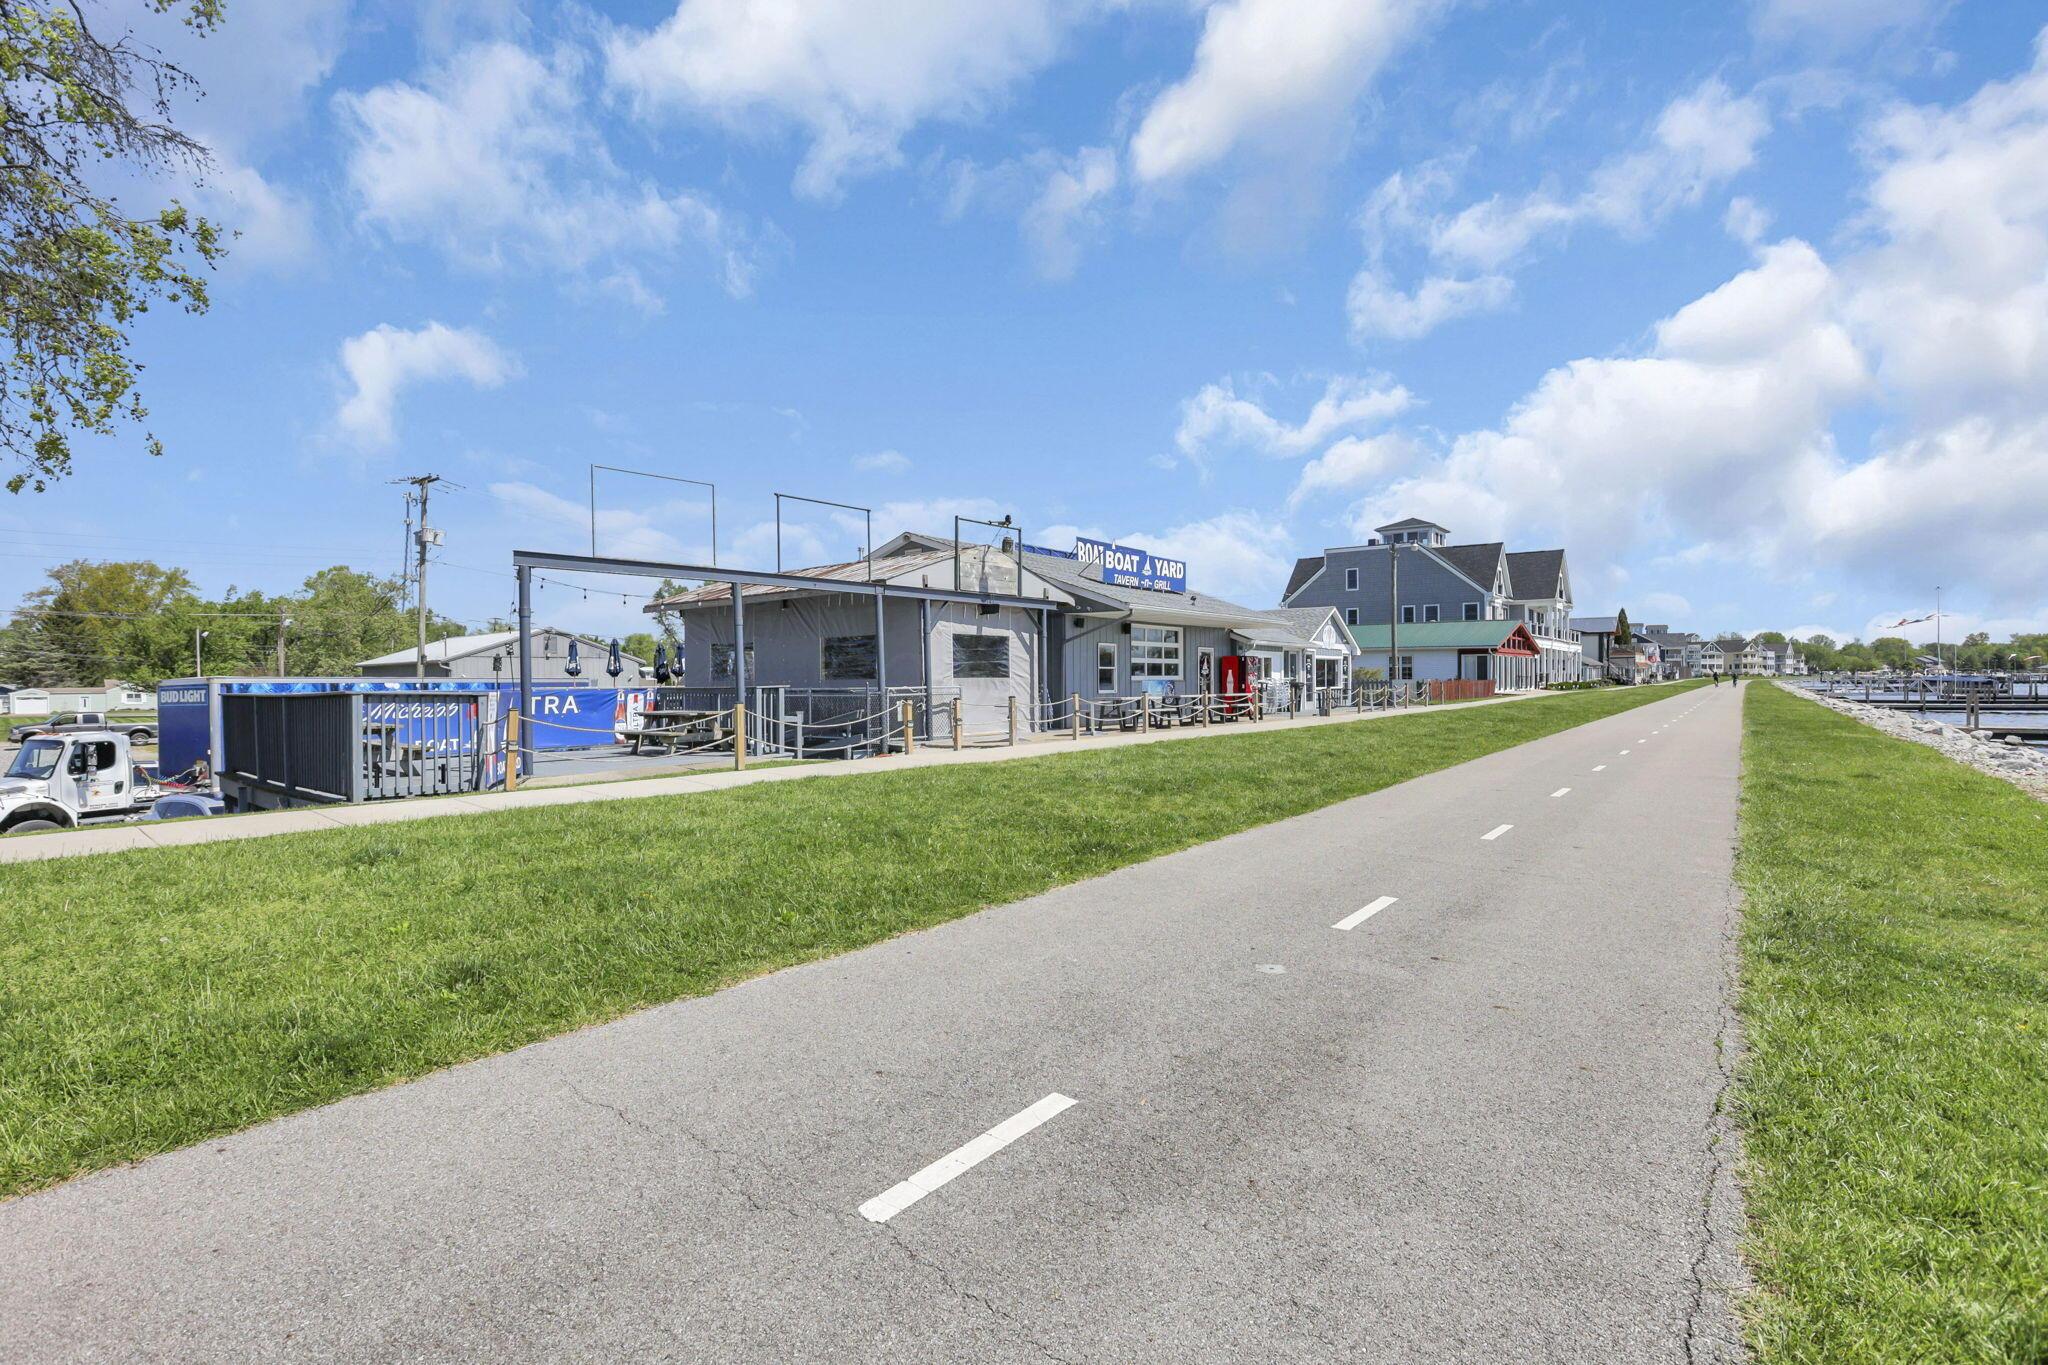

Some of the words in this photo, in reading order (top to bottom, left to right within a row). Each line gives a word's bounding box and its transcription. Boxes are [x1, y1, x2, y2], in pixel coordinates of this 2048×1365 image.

[1105, 550, 1139, 572] BOAT
[1154, 559, 1184, 579] YARD
[1114, 574, 1139, 587] TAVERN
[1154, 580, 1171, 590] GRILL
[160, 690, 179, 703] BUD
[180, 690, 206, 702] LIGHT
[531, 695, 579, 715] TRA
